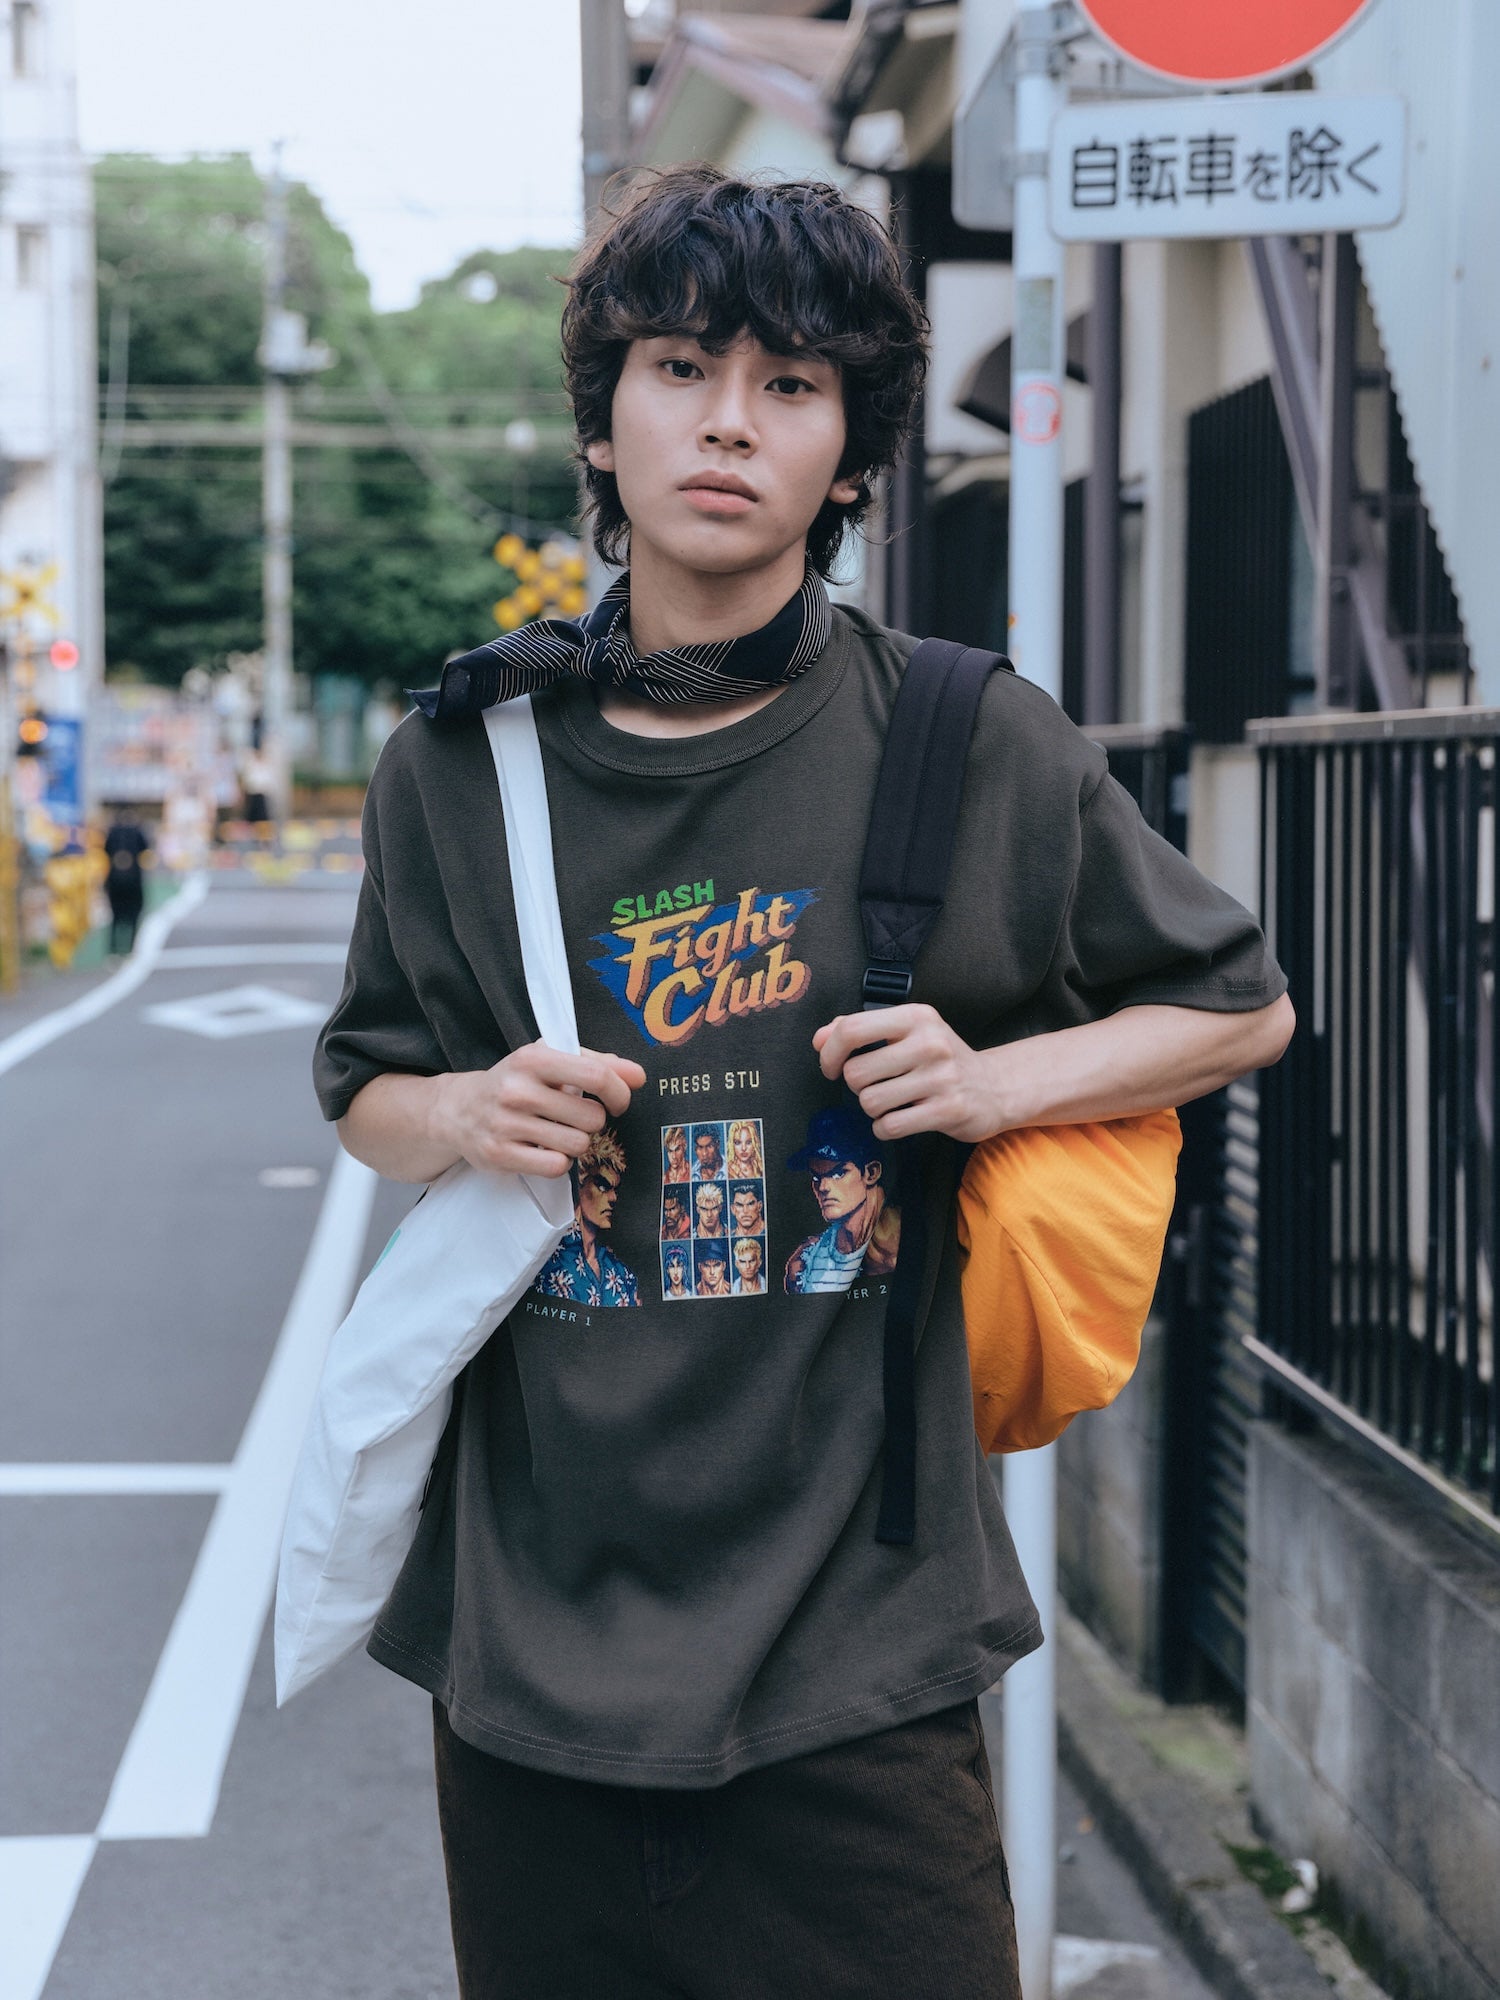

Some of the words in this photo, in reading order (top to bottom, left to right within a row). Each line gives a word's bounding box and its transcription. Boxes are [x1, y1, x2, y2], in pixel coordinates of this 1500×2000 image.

[1072, 127, 1382, 208] 自転車を除く
[610, 879, 715, 925] SLASH
[612, 887, 796, 1008] Fight
[643, 941, 812, 1046] Club
[659, 1073, 711, 1096] PRESS
[724, 1070, 760, 1090] STU
[526, 1302, 577, 1323] PLAYER
[585, 1316, 592, 1327] 1
[846, 1287, 869, 1300] YER
[879, 1284, 888, 1295] 2
